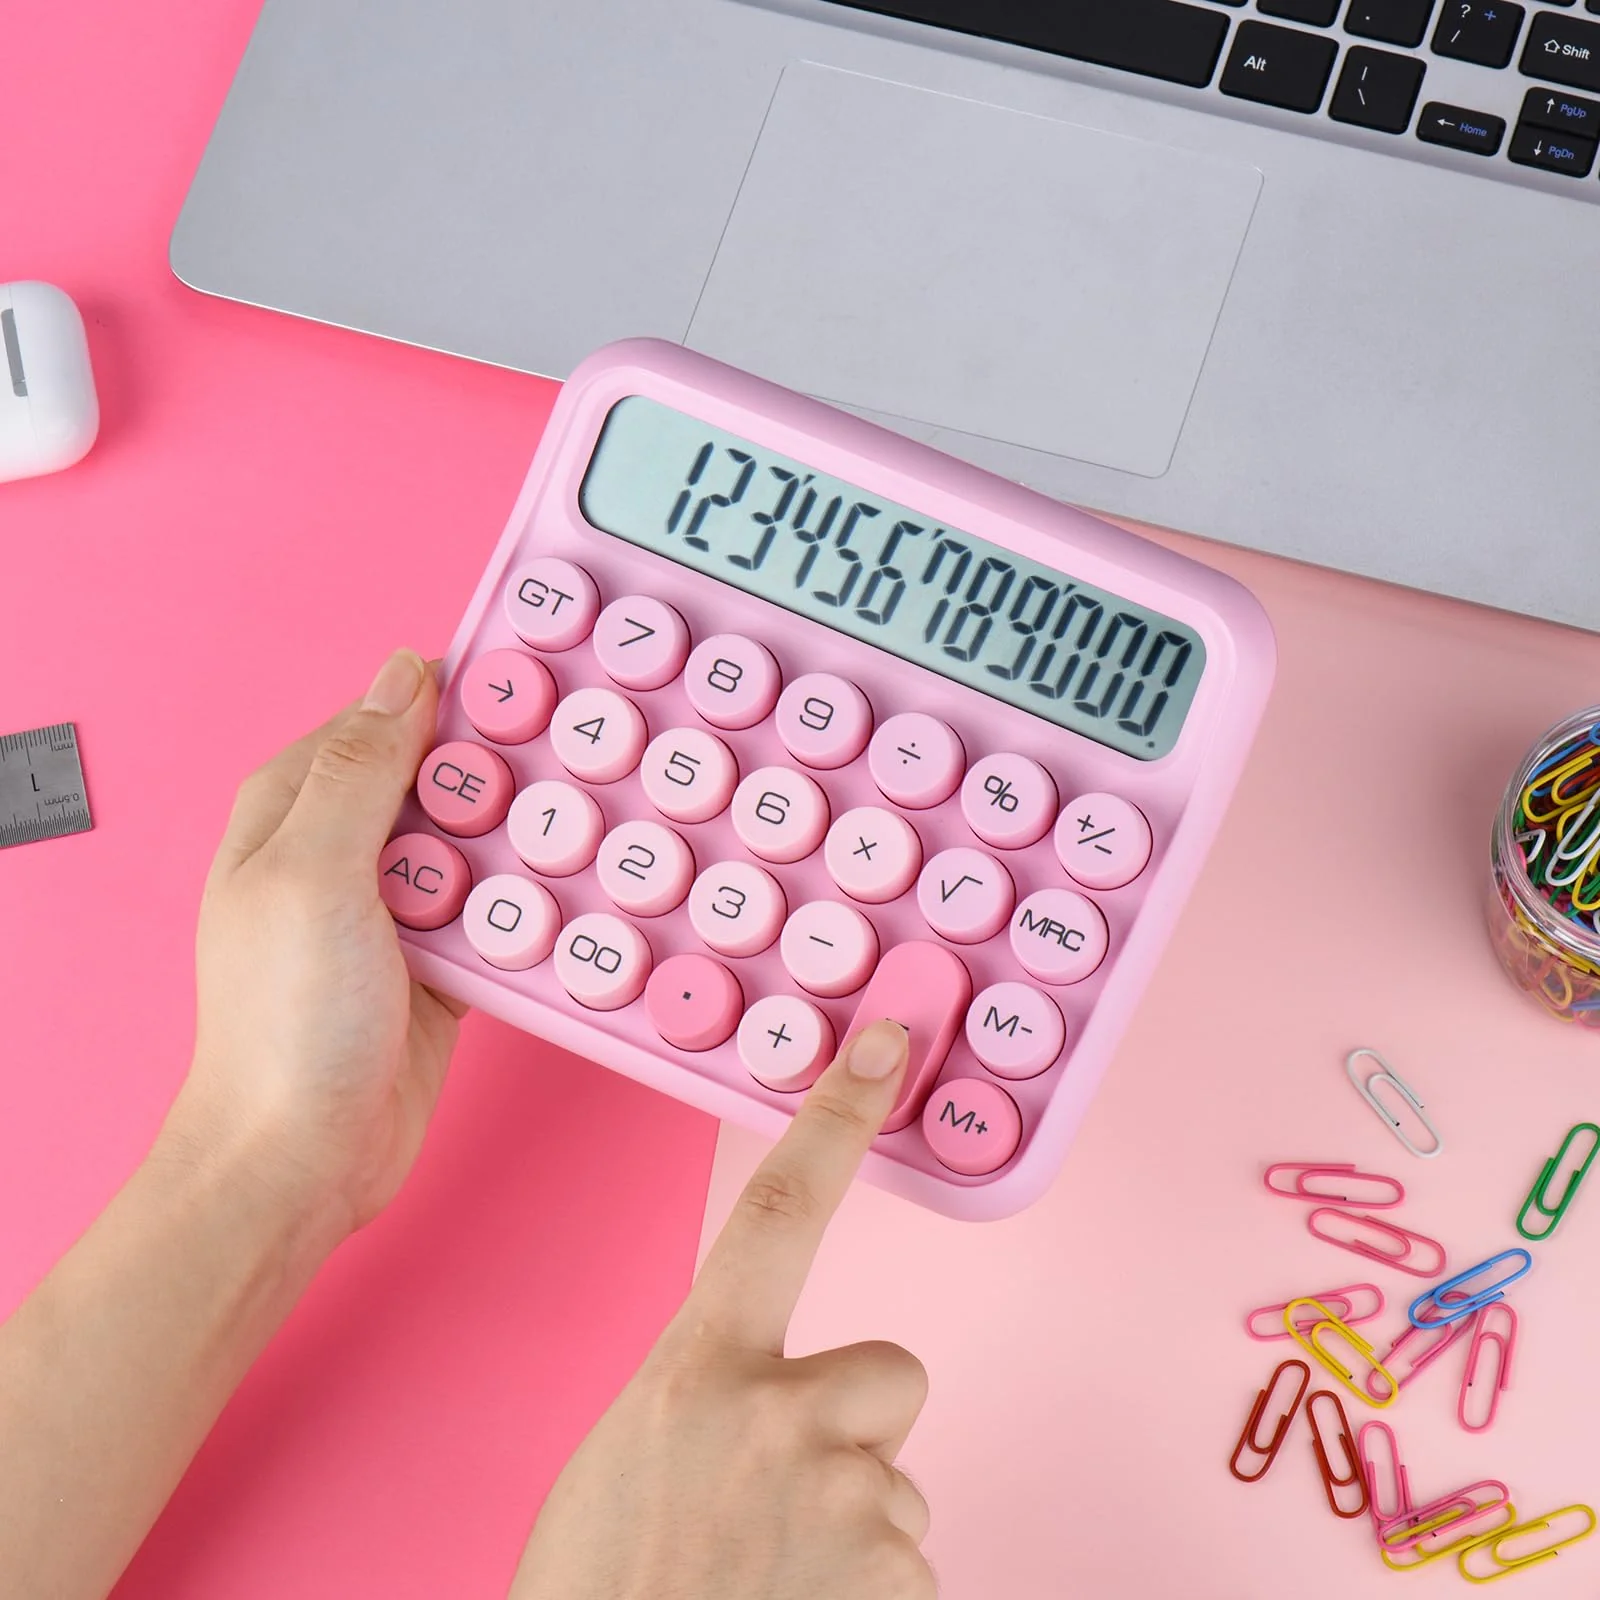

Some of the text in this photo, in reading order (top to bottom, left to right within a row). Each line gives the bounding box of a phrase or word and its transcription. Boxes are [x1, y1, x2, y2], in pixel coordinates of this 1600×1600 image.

[1461, 3, 1471, 18] ?
[1243, 55, 1267, 72] Alt
[1561, 44, 1591, 60] Shift
[1560, 103, 1587, 118] PgUp
[1459, 123, 1487, 137] Home
[1548, 145, 1575, 159] PgDn
[518, 578, 574, 616] GT
[618, 617, 656, 647] 7
[707, 658, 743, 693] 8
[799, 697, 834, 731] 9
[572, 717, 605, 745] 4
[430, 759, 487, 803] CE
[664, 750, 701, 786] 5
[44, 793, 79, 805] 0.5mm
[755, 791, 790, 825] 6
[983, 775, 1019, 813] %
[542, 808, 557, 836] 1
[383, 854, 444, 895] AC
[618, 844, 656, 881] 2
[487, 899, 522, 933] 0
[711, 886, 746, 919] 3
[1018, 908, 1086, 952] MRC
[569, 934, 622, 974] 00
[767, 1023, 792, 1049] +
[983, 1006, 1033, 1037] M-
[939, 1100, 988, 1135] M+
